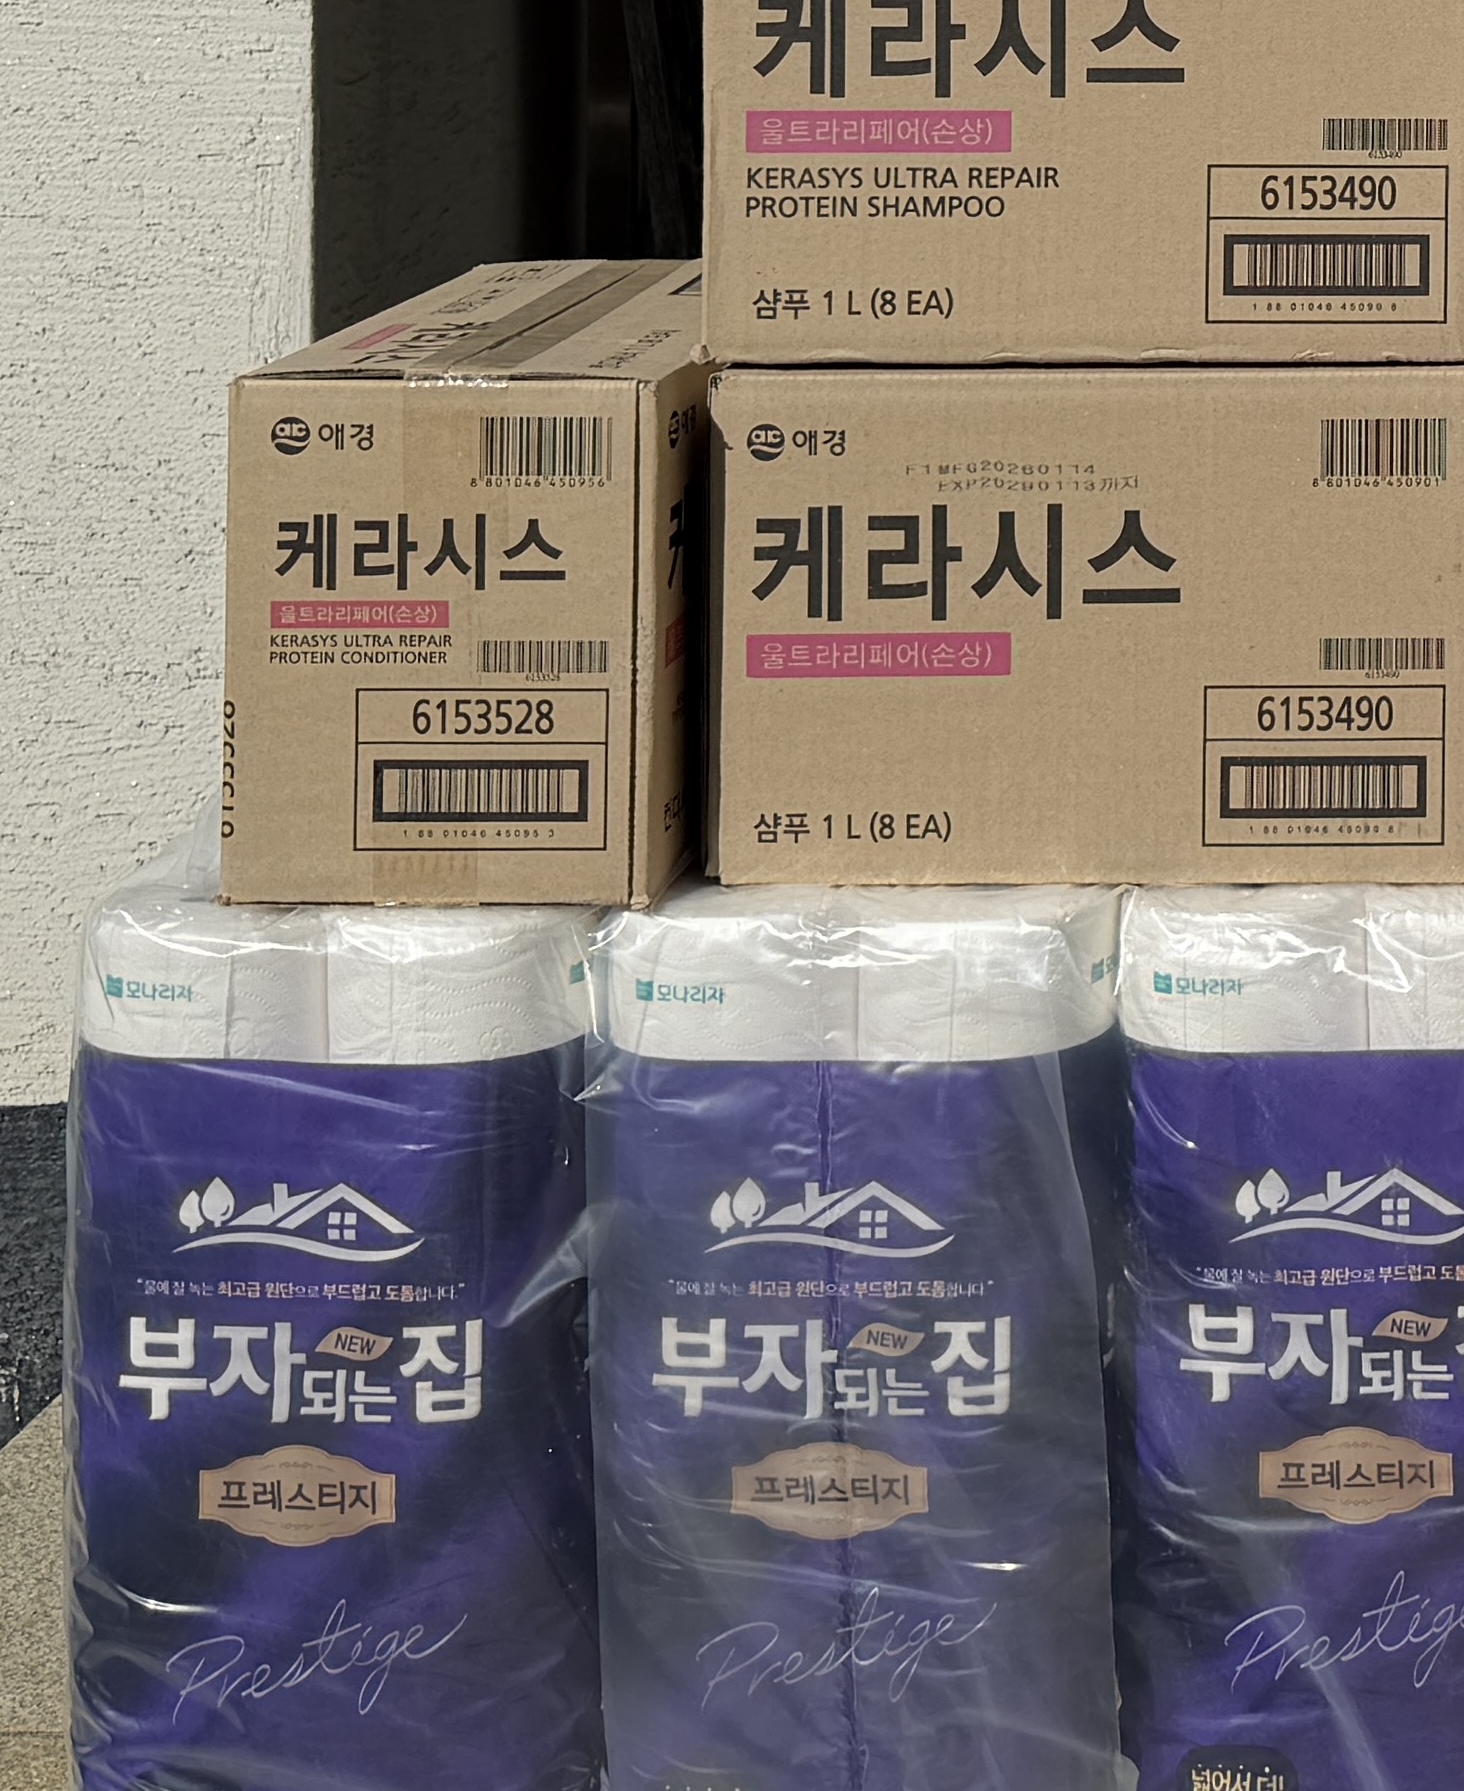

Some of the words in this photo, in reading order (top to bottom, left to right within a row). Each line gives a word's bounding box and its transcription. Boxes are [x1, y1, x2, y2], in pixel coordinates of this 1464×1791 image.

[759, 116, 994, 148] 울트라리페어(손상)
[745, 166, 865, 190] KERASYS
[872, 166, 961, 189] ULTRA
[969, 166, 1061, 189] REPAIR
[1259, 174, 1398, 213] 6153490
[744, 195, 859, 219] PROTEIN
[867, 195, 1006, 218] SHAMPOO
[751, 290, 809, 321] 샴푸
[905, 288, 954, 319] EA)
[318, 422, 376, 452] 애경
[792, 427, 847, 457] 애경
[274, 512, 567, 592] 케라시스
[751, 503, 1182, 622] 케라시스
[269, 633, 339, 649] KERASYS
[343, 633, 393, 649] ULTRA
[399, 633, 453, 649] REPAIR
[269, 650, 336, 665] PROTEIN
[340, 649, 449, 665] CONDITIONER
[759, 640, 994, 672] 울트라리페어(손상)
[411, 698, 555, 736] 6153528
[1255, 695, 1395, 733] 6153490
[125, 981, 194, 1003] 모나리자
[866, 1327, 909, 1351] NEW
[1389, 1317, 1431, 1338] NEW
[333, 1331, 377, 1357] NEW
[750, 1474, 911, 1506] 프레스티지
[1276, 1458, 1436, 1491] 프레스티지
[217, 1480, 378, 1516] 프레스티지
[165, 1598, 468, 1726] Prestige
[696, 1586, 998, 1710] Prestige
